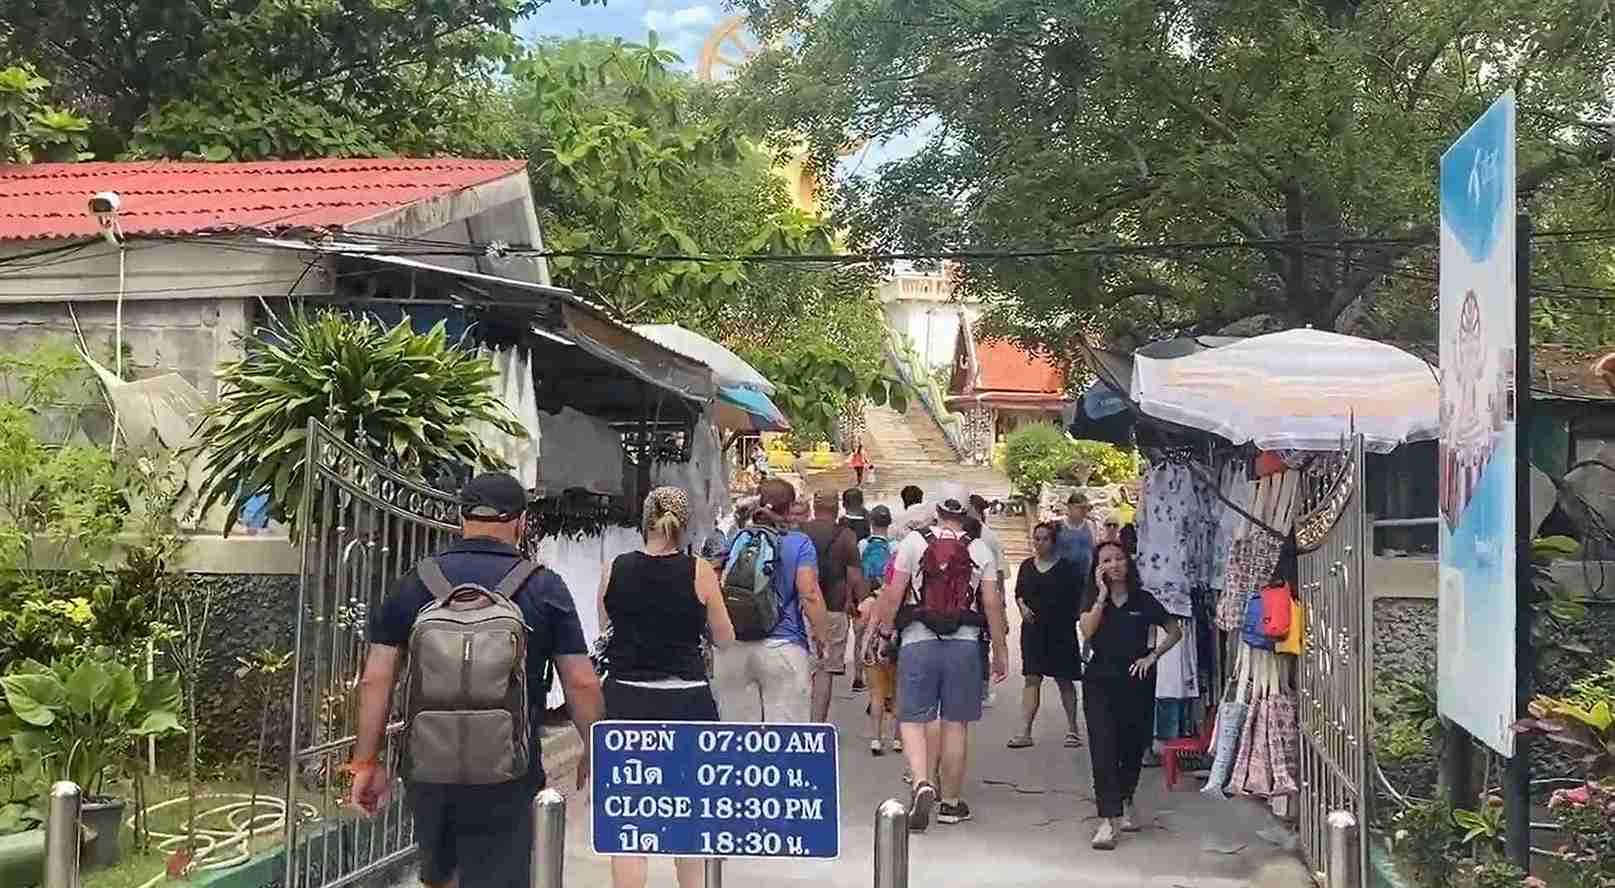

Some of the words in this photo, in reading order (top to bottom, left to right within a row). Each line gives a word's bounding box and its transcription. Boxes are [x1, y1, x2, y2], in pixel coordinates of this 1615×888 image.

[605, 730, 676, 751] OPEN
[698, 731, 780, 752] 07:00
[785, 732, 825, 753] AM
[612, 758, 663, 784] เปิด
[697, 764, 780, 786] 07:00
[787, 769, 810, 787] น.
[604, 796, 692, 817] CLOSE
[700, 797, 780, 819] 18:30
[784, 798, 823, 819] PM
[619, 824, 659, 851] ปิด
[701, 832, 781, 854] 18:30
[787, 836, 810, 854] น.
